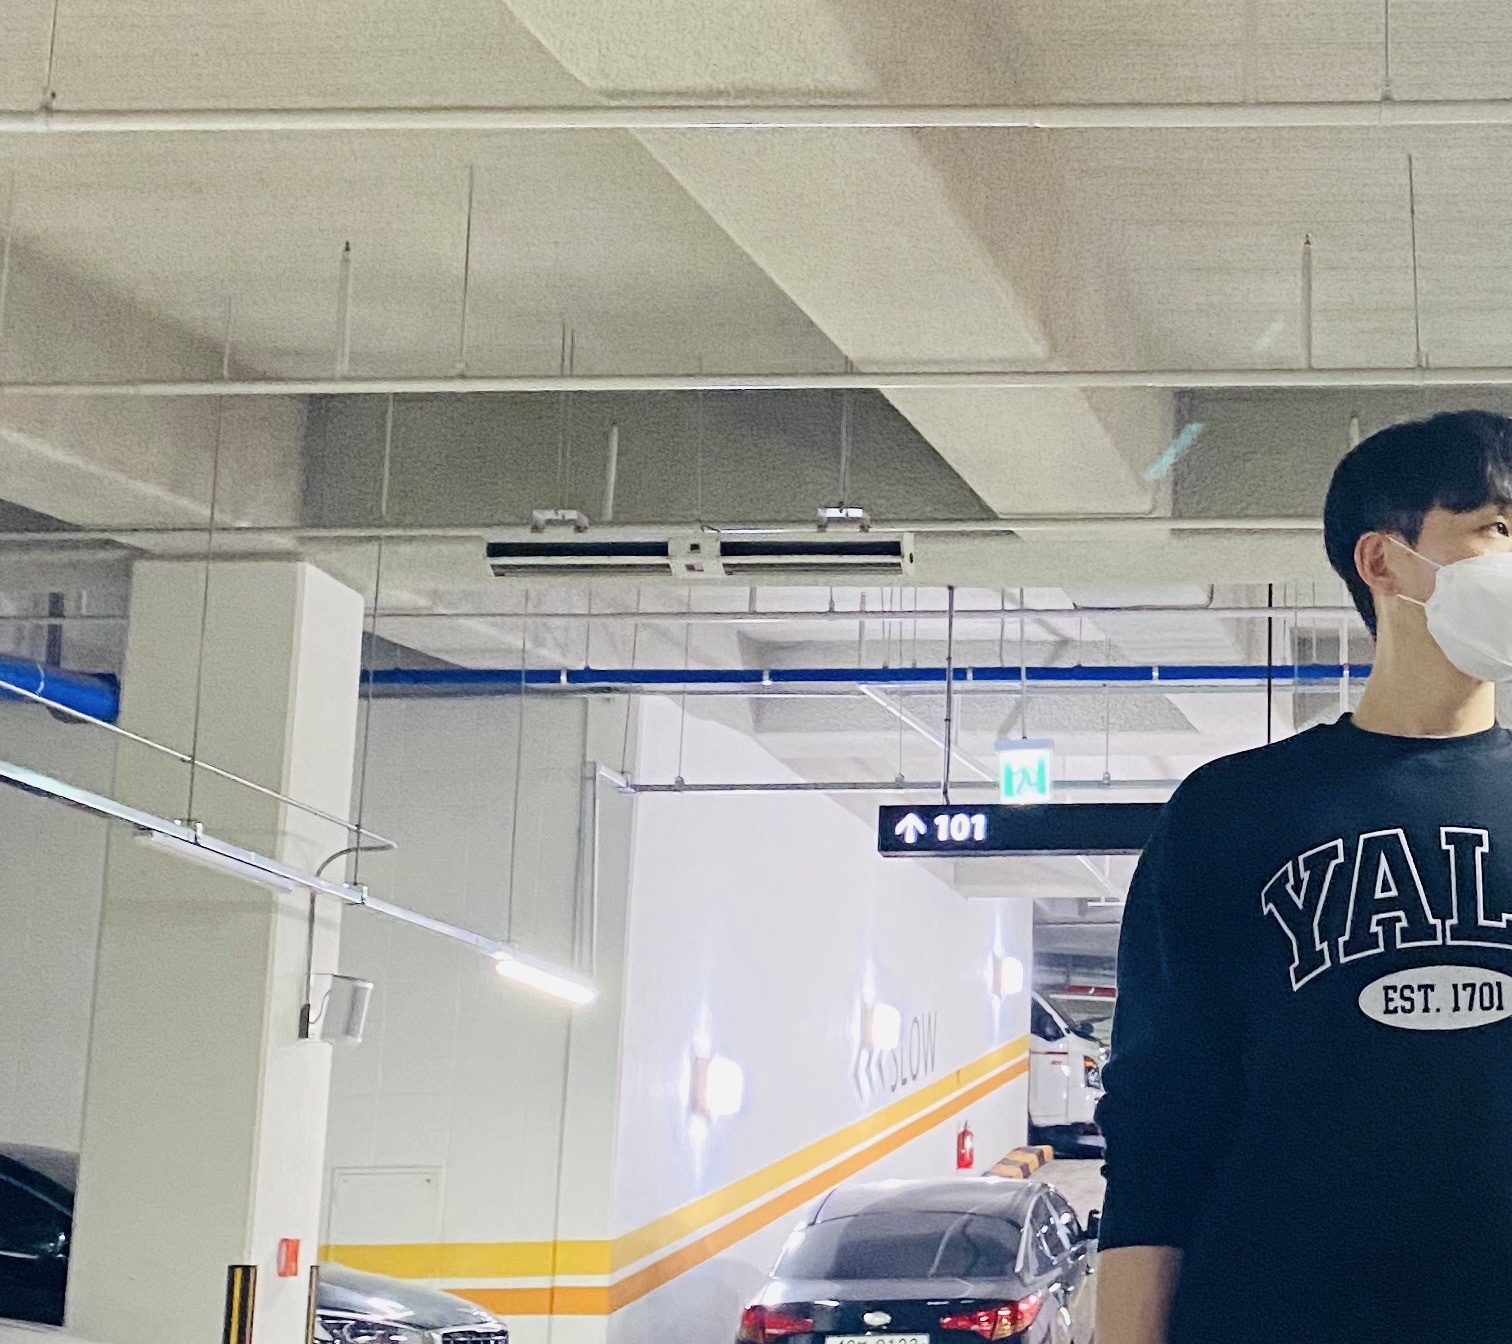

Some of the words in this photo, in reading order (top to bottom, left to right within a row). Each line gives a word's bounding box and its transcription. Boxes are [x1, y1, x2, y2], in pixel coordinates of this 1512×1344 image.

[934, 813, 986, 842] 101
[1382, 983, 1441, 1015] EST.
[1452, 981, 1505, 1013] 1701
